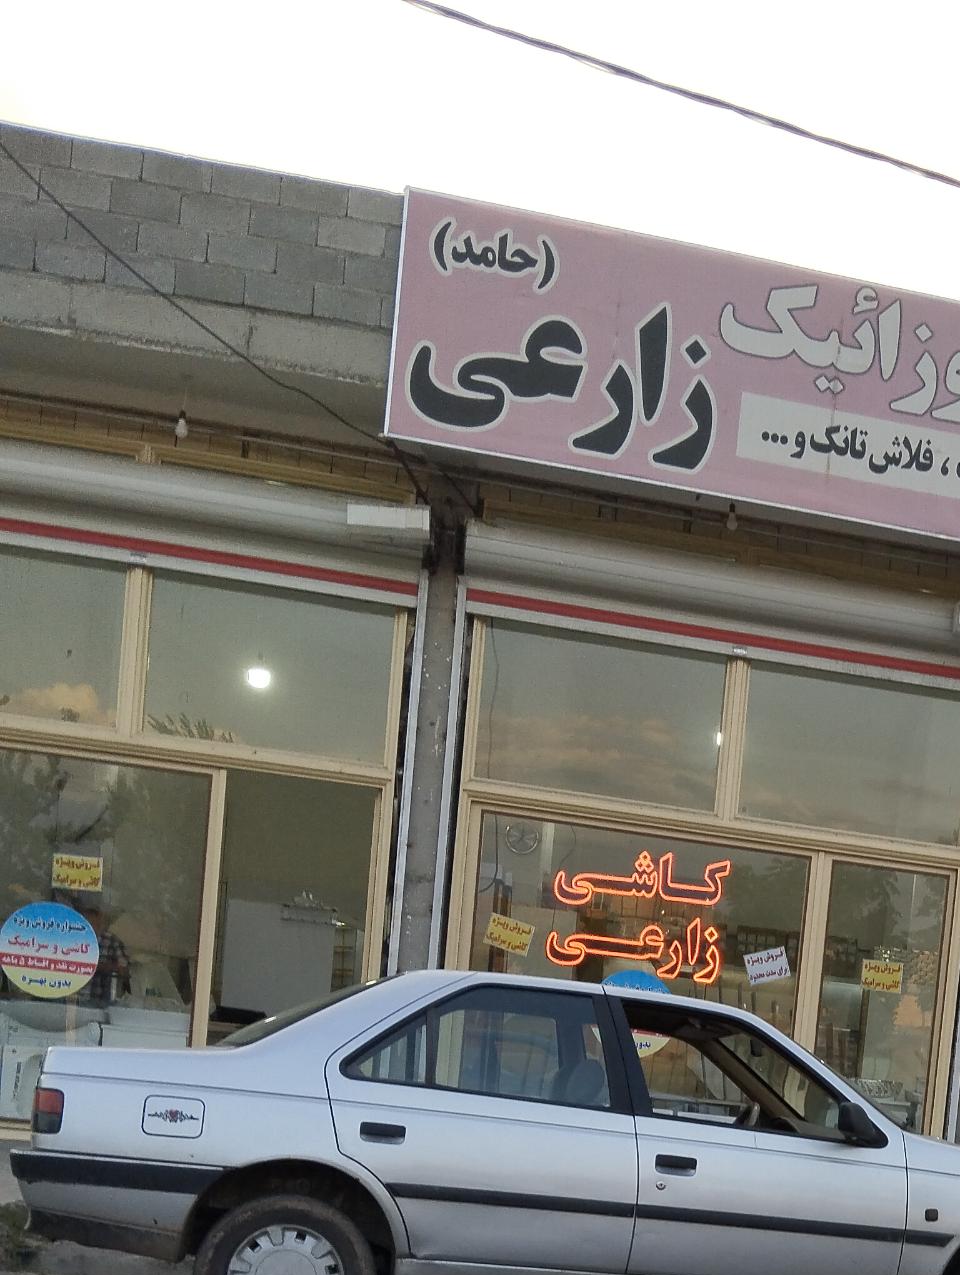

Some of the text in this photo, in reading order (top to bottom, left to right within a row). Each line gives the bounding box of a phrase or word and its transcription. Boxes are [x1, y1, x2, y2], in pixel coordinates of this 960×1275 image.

[432, 219, 557, 290] (حامد)
[407, 303, 715, 472] زارعی
[809, 425, 869, 459] تانک
[868, 436, 934, 474] فلاش
[553, 850, 732, 906] کاشی
[545, 917, 721, 985] زارعی
